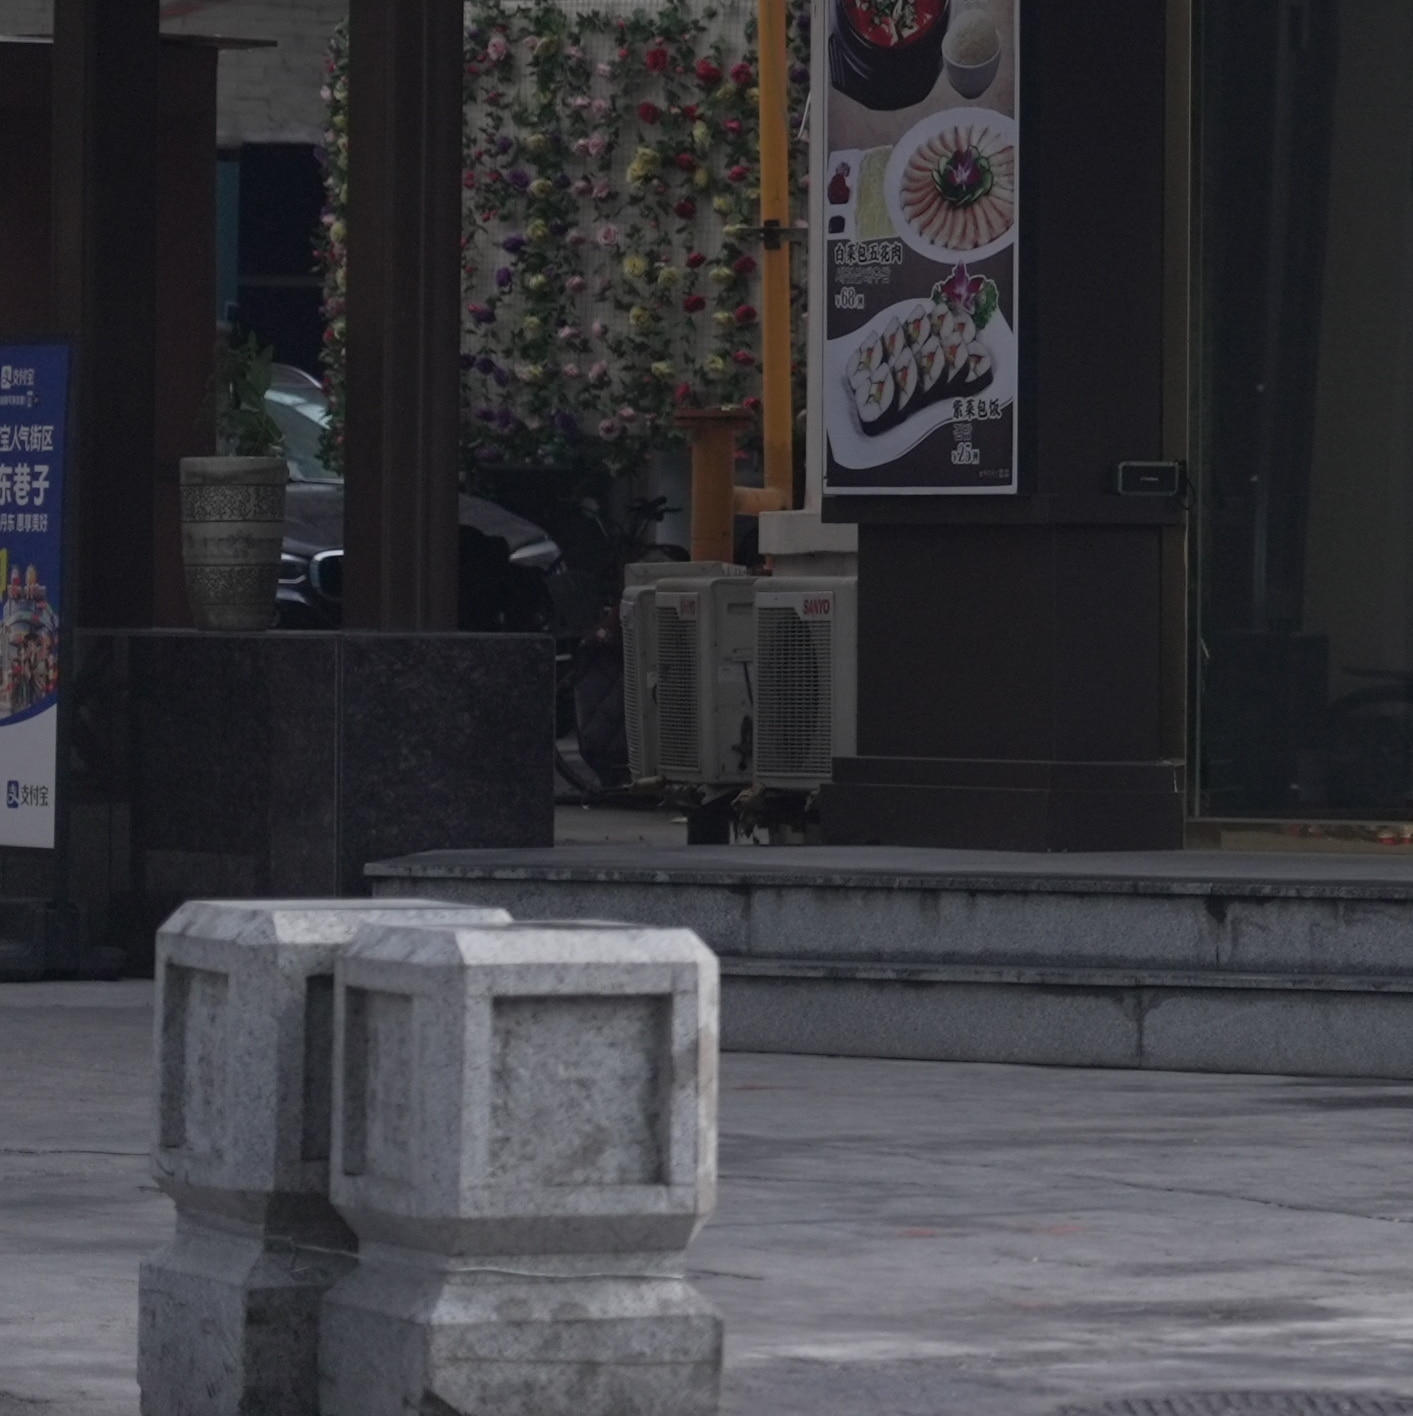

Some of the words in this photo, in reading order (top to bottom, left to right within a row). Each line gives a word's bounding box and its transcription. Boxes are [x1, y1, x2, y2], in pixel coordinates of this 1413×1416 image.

[836, 242, 902, 264] 白菜包五花肉
[803, 599, 830, 615] SANYO
[21, 784, 49, 806] 支付宝
